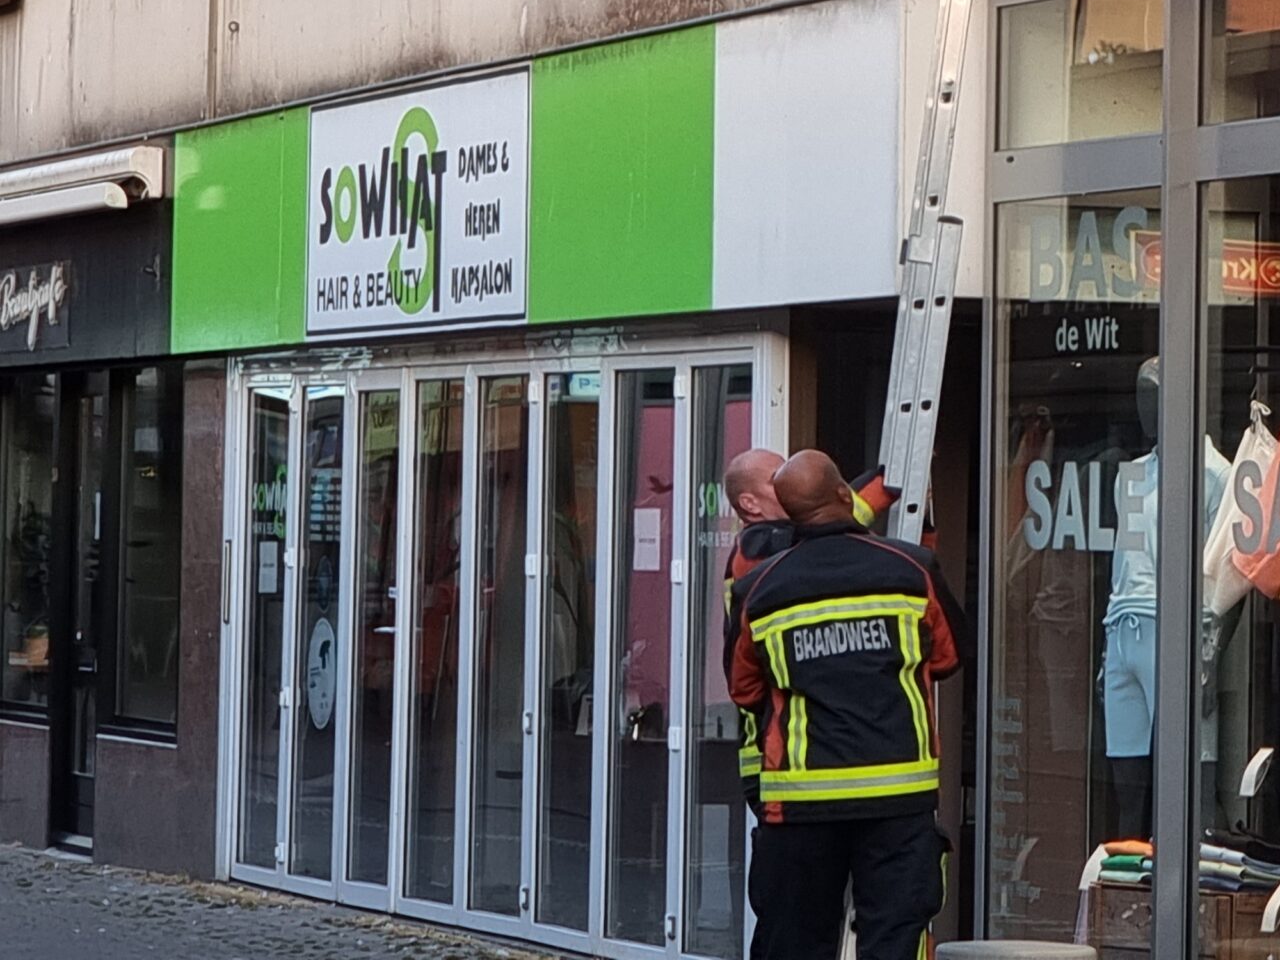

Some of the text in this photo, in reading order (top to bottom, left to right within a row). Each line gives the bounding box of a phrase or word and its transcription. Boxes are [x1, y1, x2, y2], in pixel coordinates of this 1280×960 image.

[458, 142, 497, 183] DAMES
[319, 147, 447, 313] SOWHAT
[465, 198, 501, 241] HEREN
[1029, 206, 1148, 302] BAS
[317, 268, 421, 313] HAIR & BEAUTY
[452, 258, 512, 304] KAPSALON
[1055, 316, 1119, 352] de Wit
[1023, 459, 1148, 552] SALE
[793, 618, 891, 662] BRANDWEER
